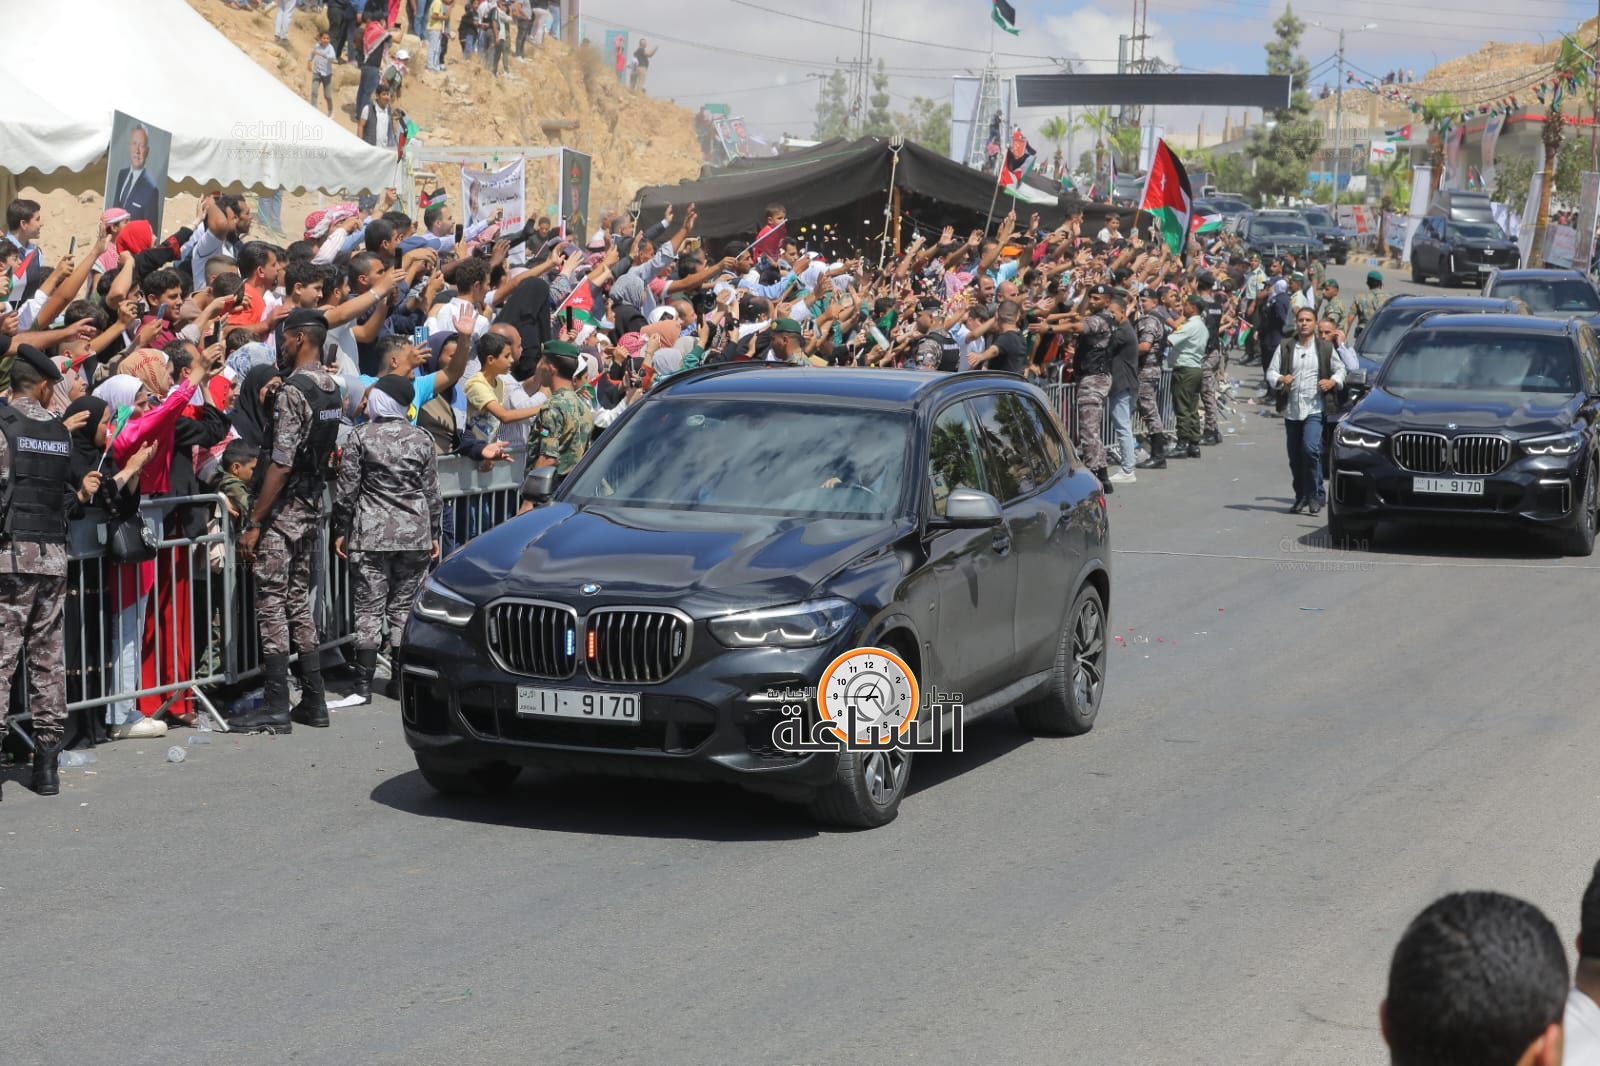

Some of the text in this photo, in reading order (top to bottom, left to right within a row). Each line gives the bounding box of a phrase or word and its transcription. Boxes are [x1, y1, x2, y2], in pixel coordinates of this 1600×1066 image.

[19, 438, 69, 454] GENDARMERIE
[1451, 481, 1481, 493] 9170
[582, 694, 635, 718] 9170
